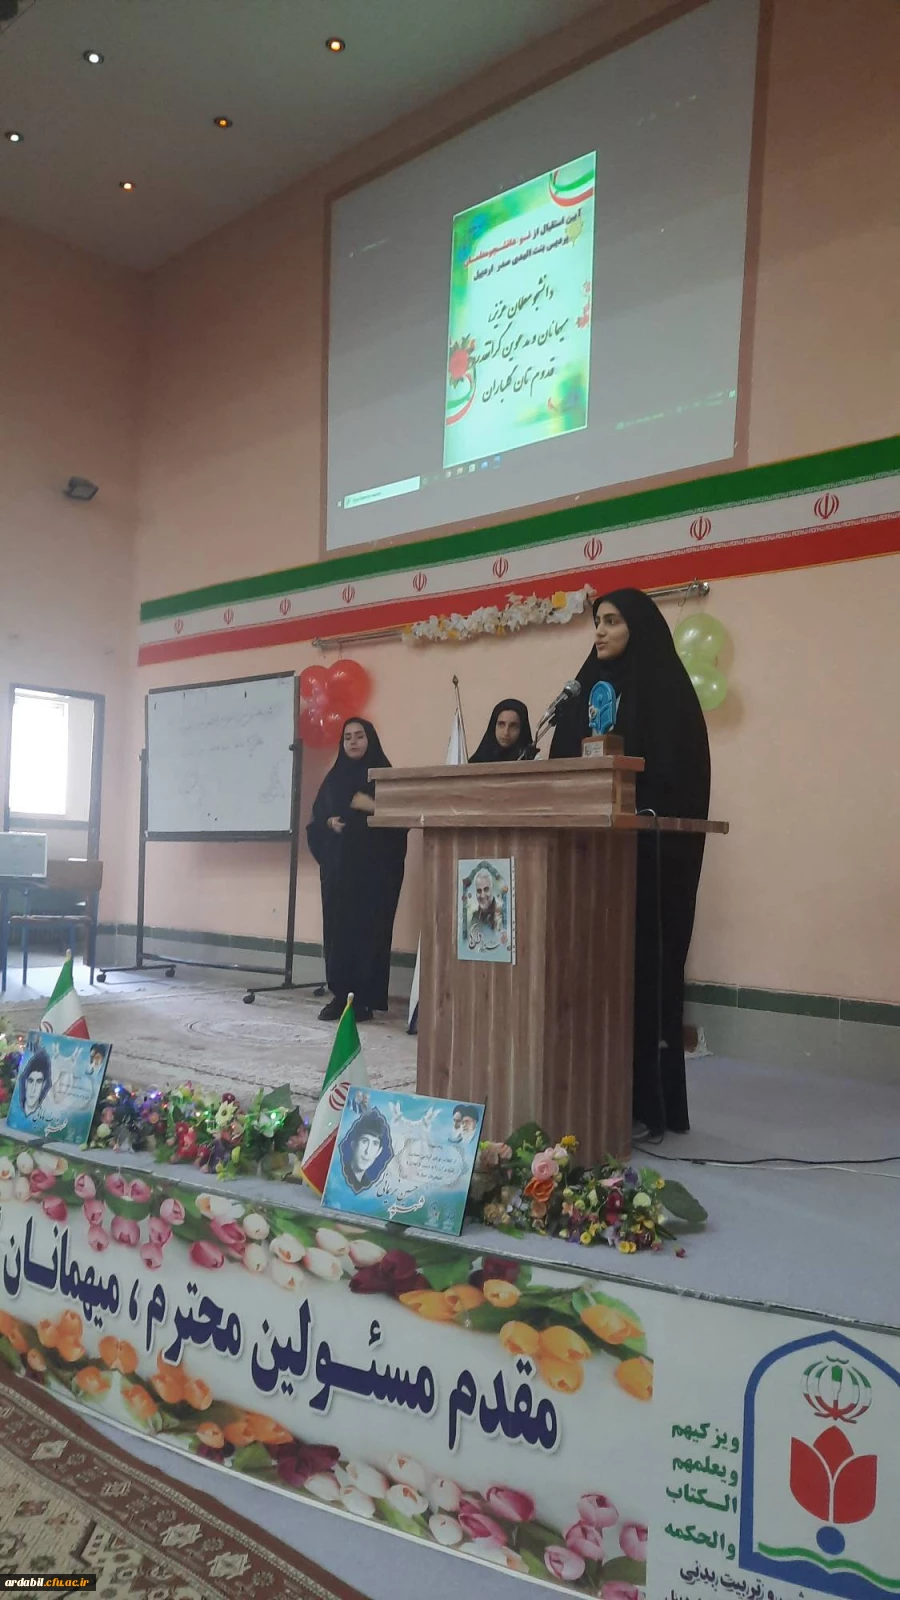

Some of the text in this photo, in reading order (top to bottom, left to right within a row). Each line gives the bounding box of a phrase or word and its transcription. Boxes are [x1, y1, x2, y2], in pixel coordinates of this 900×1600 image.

[532, 227, 540, 239] از
[540, 216, 565, 235] استقبال
[546, 236, 570, 252] پردیس
[473, 264, 494, 281] اردبیل
[496, 259, 511, 272] صدر
[3, 1216, 120, 1328] میهمانان
[250, 1298, 435, 1414] مسئولین
[449, 1357, 558, 1451] مقدم
[665, 1483, 738, 1514] الکتاب
[680, 1560, 718, 1591] بدنی
